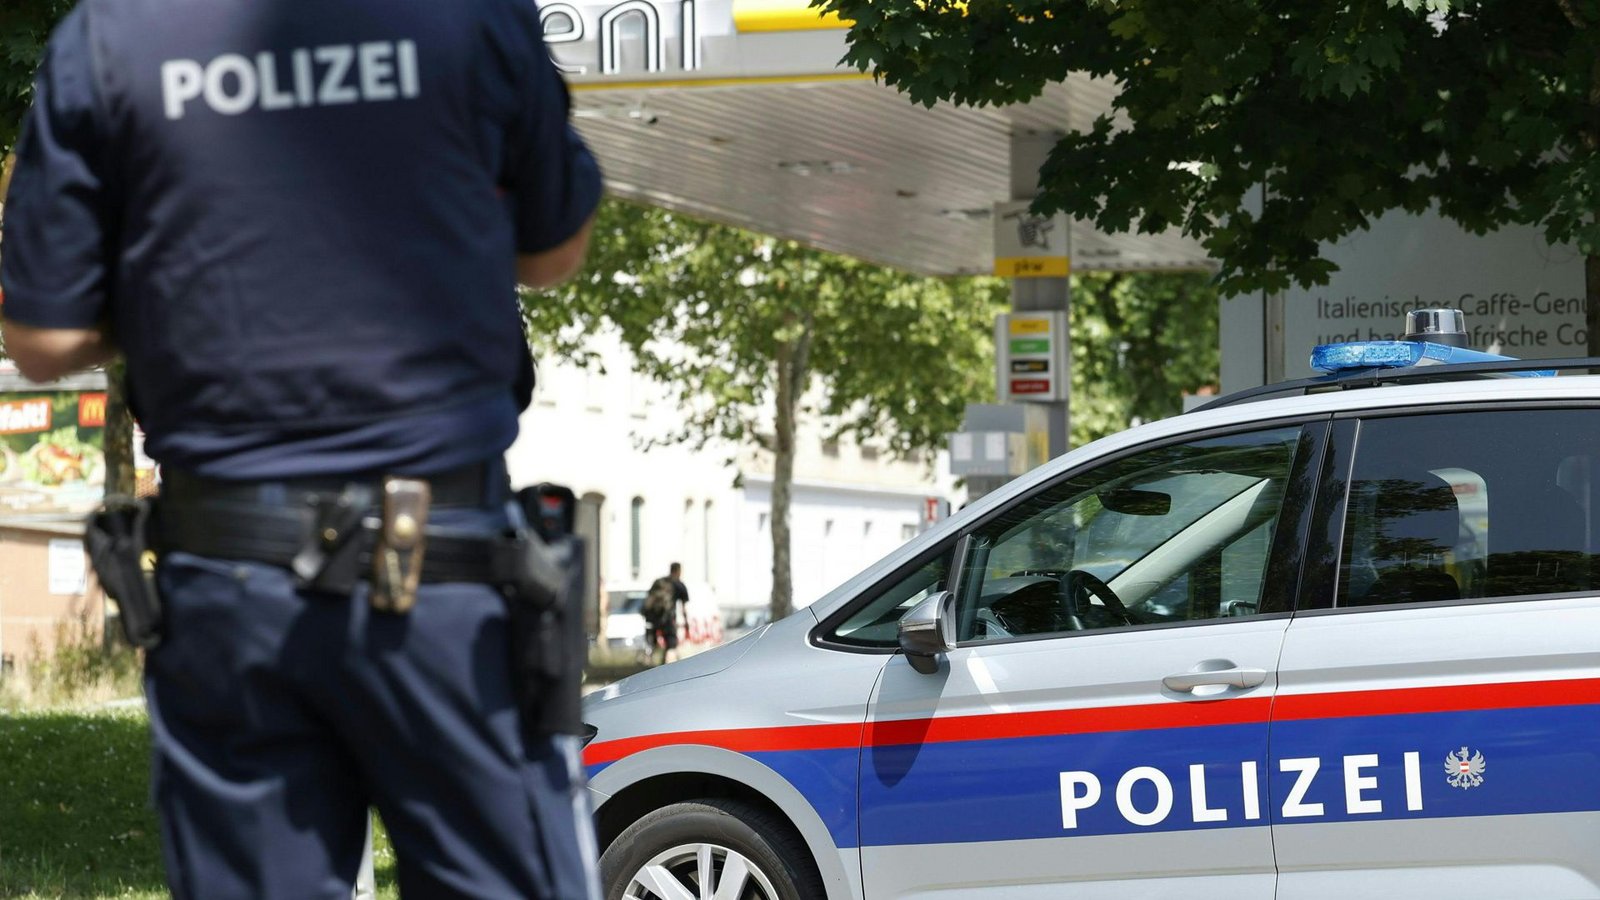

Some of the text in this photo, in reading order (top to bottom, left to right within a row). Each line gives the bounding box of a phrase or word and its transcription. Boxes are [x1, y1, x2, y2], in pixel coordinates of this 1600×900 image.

[539, 0, 700, 74] eni
[161, 39, 420, 120] POLIZEI
[1059, 751, 1424, 829] POLIZEI
